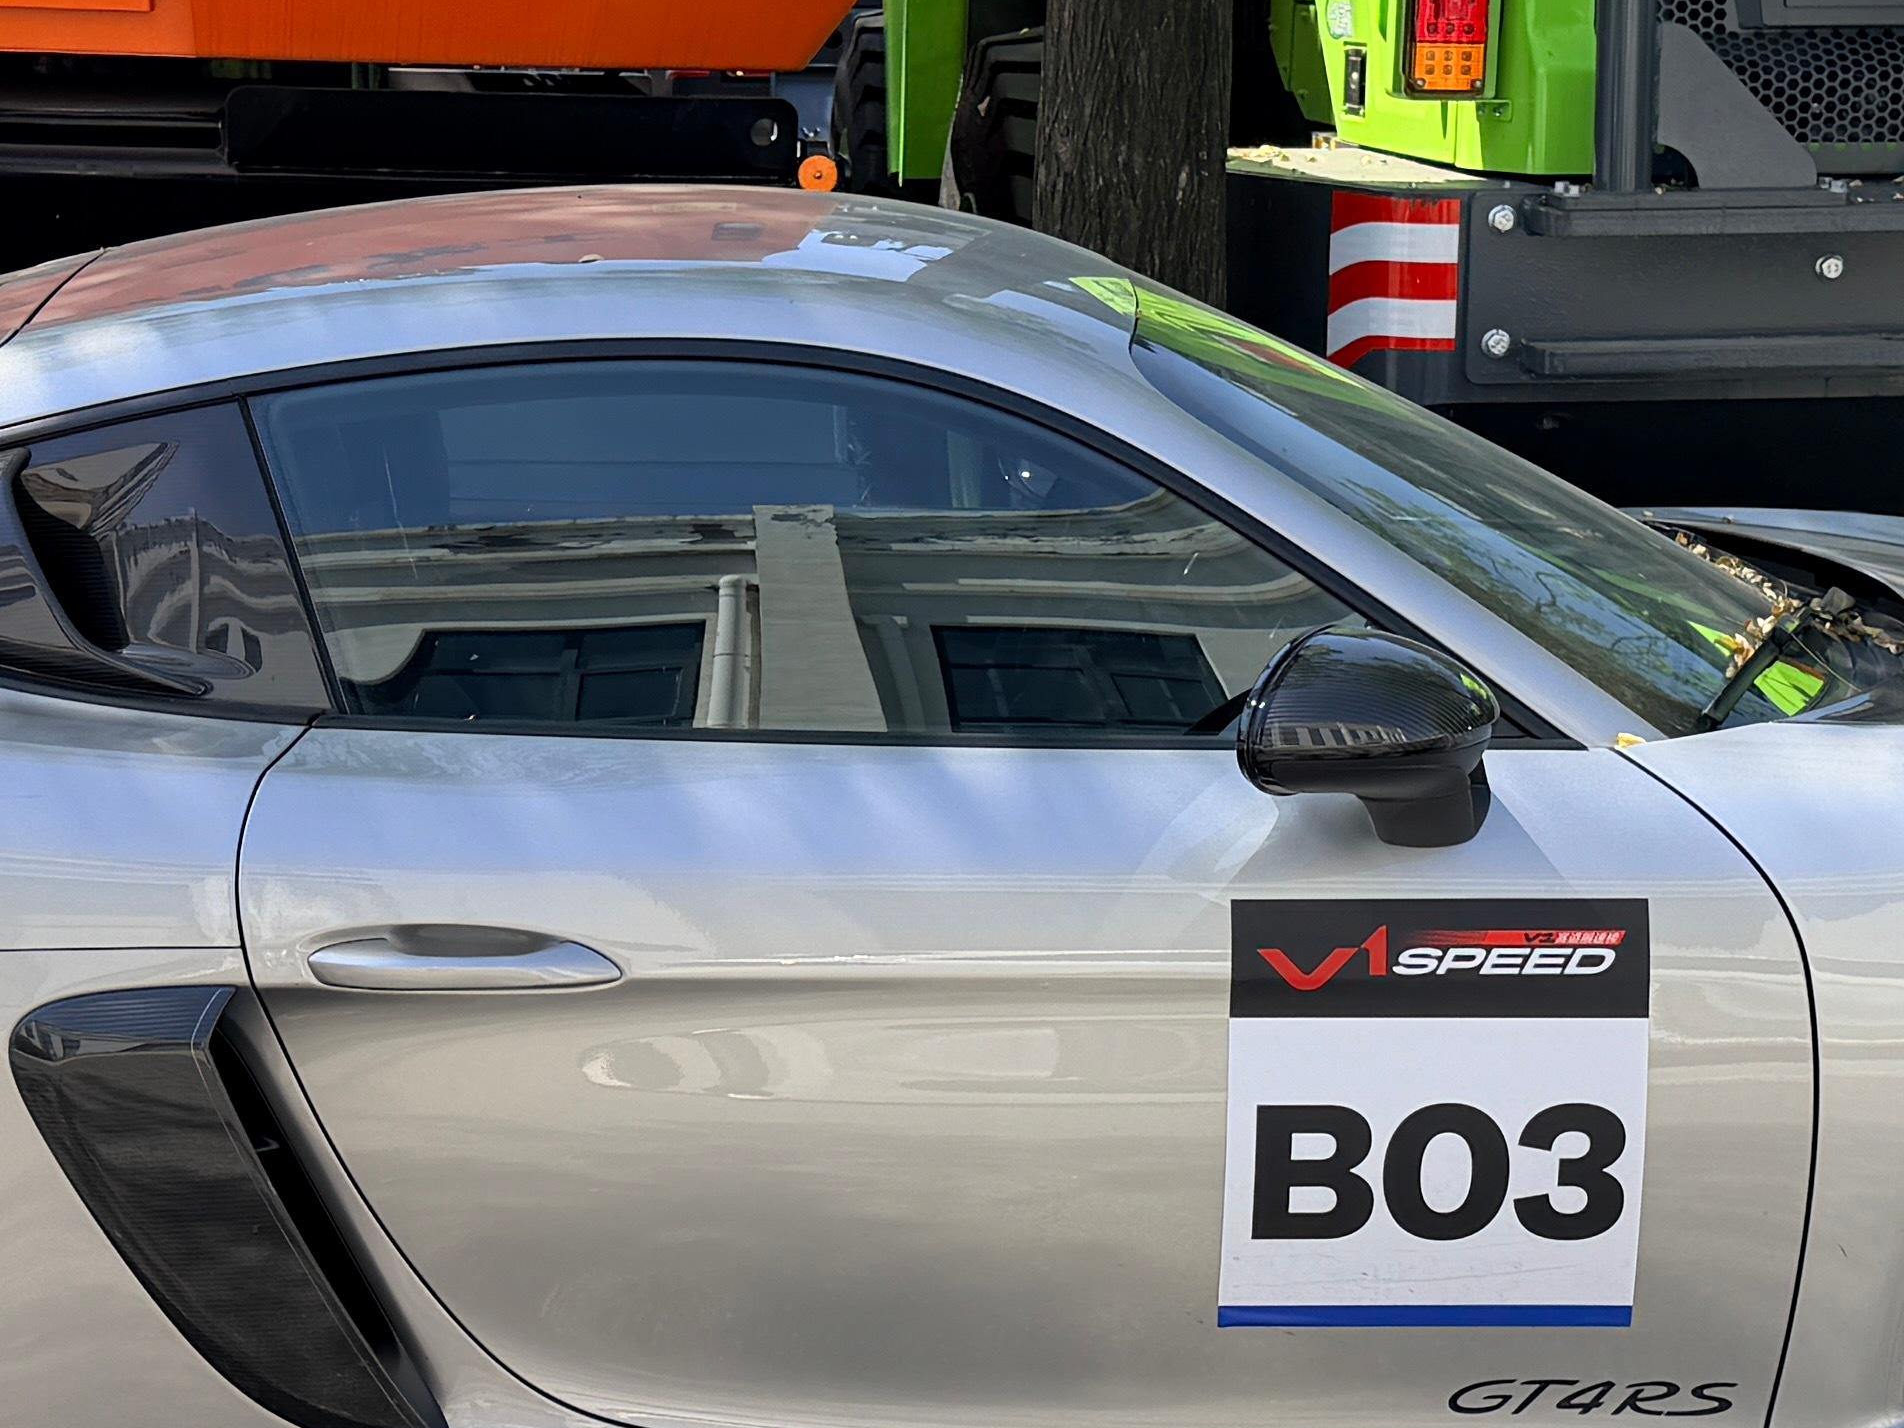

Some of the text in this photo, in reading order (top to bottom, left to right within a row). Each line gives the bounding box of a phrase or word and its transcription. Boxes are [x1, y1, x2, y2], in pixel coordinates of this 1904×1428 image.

[1391, 946, 1616, 976] SPEED
[1250, 1102, 1627, 1241] B03
[1447, 1378, 1740, 1417] GT4RS
